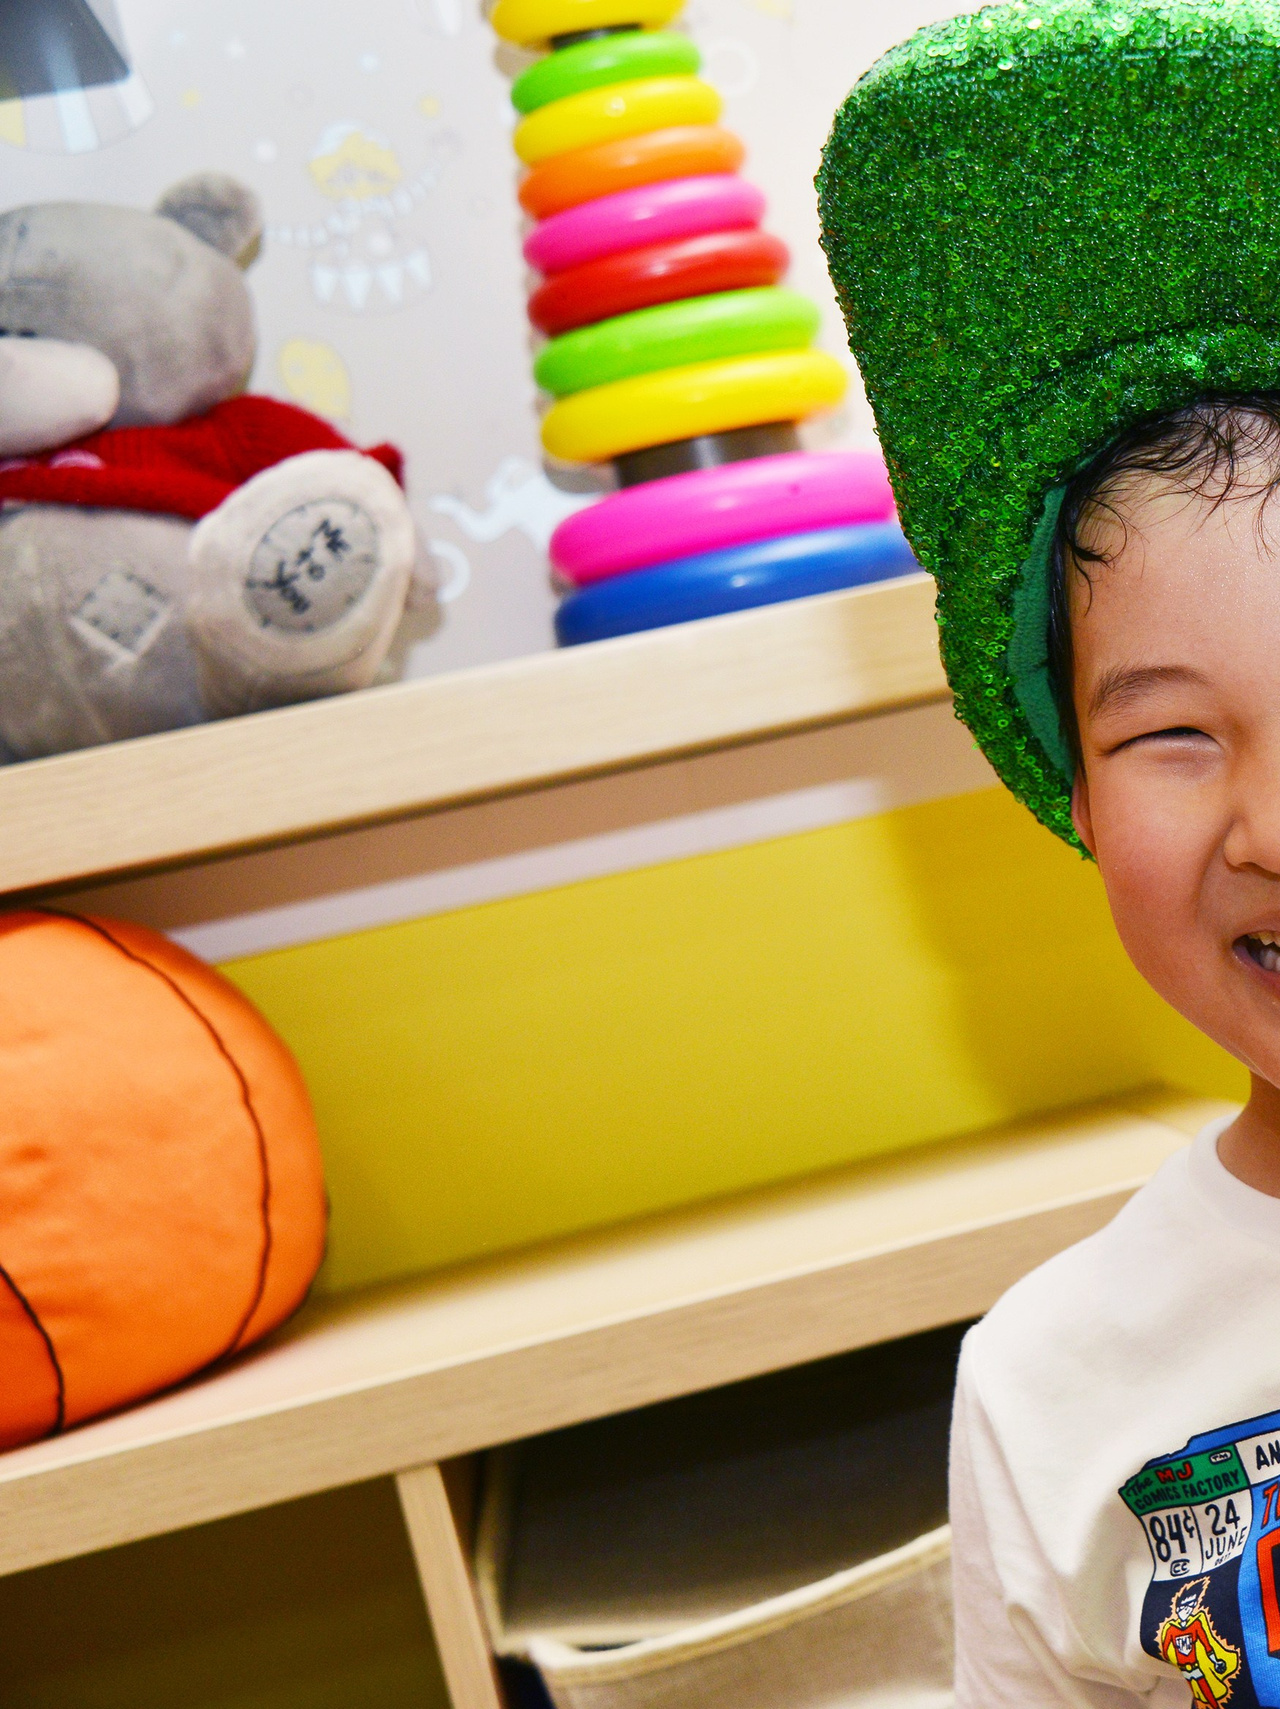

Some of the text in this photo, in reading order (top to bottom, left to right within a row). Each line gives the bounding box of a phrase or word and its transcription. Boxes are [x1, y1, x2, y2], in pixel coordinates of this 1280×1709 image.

[1135, 1468, 1241, 1511] COMICS FACTORY
[1155, 1459, 1195, 1483] MJ
[1149, 1509, 1196, 1563] 84¢
[1204, 1498, 1241, 1536] 24
[1204, 1525, 1248, 1560] JUNE
